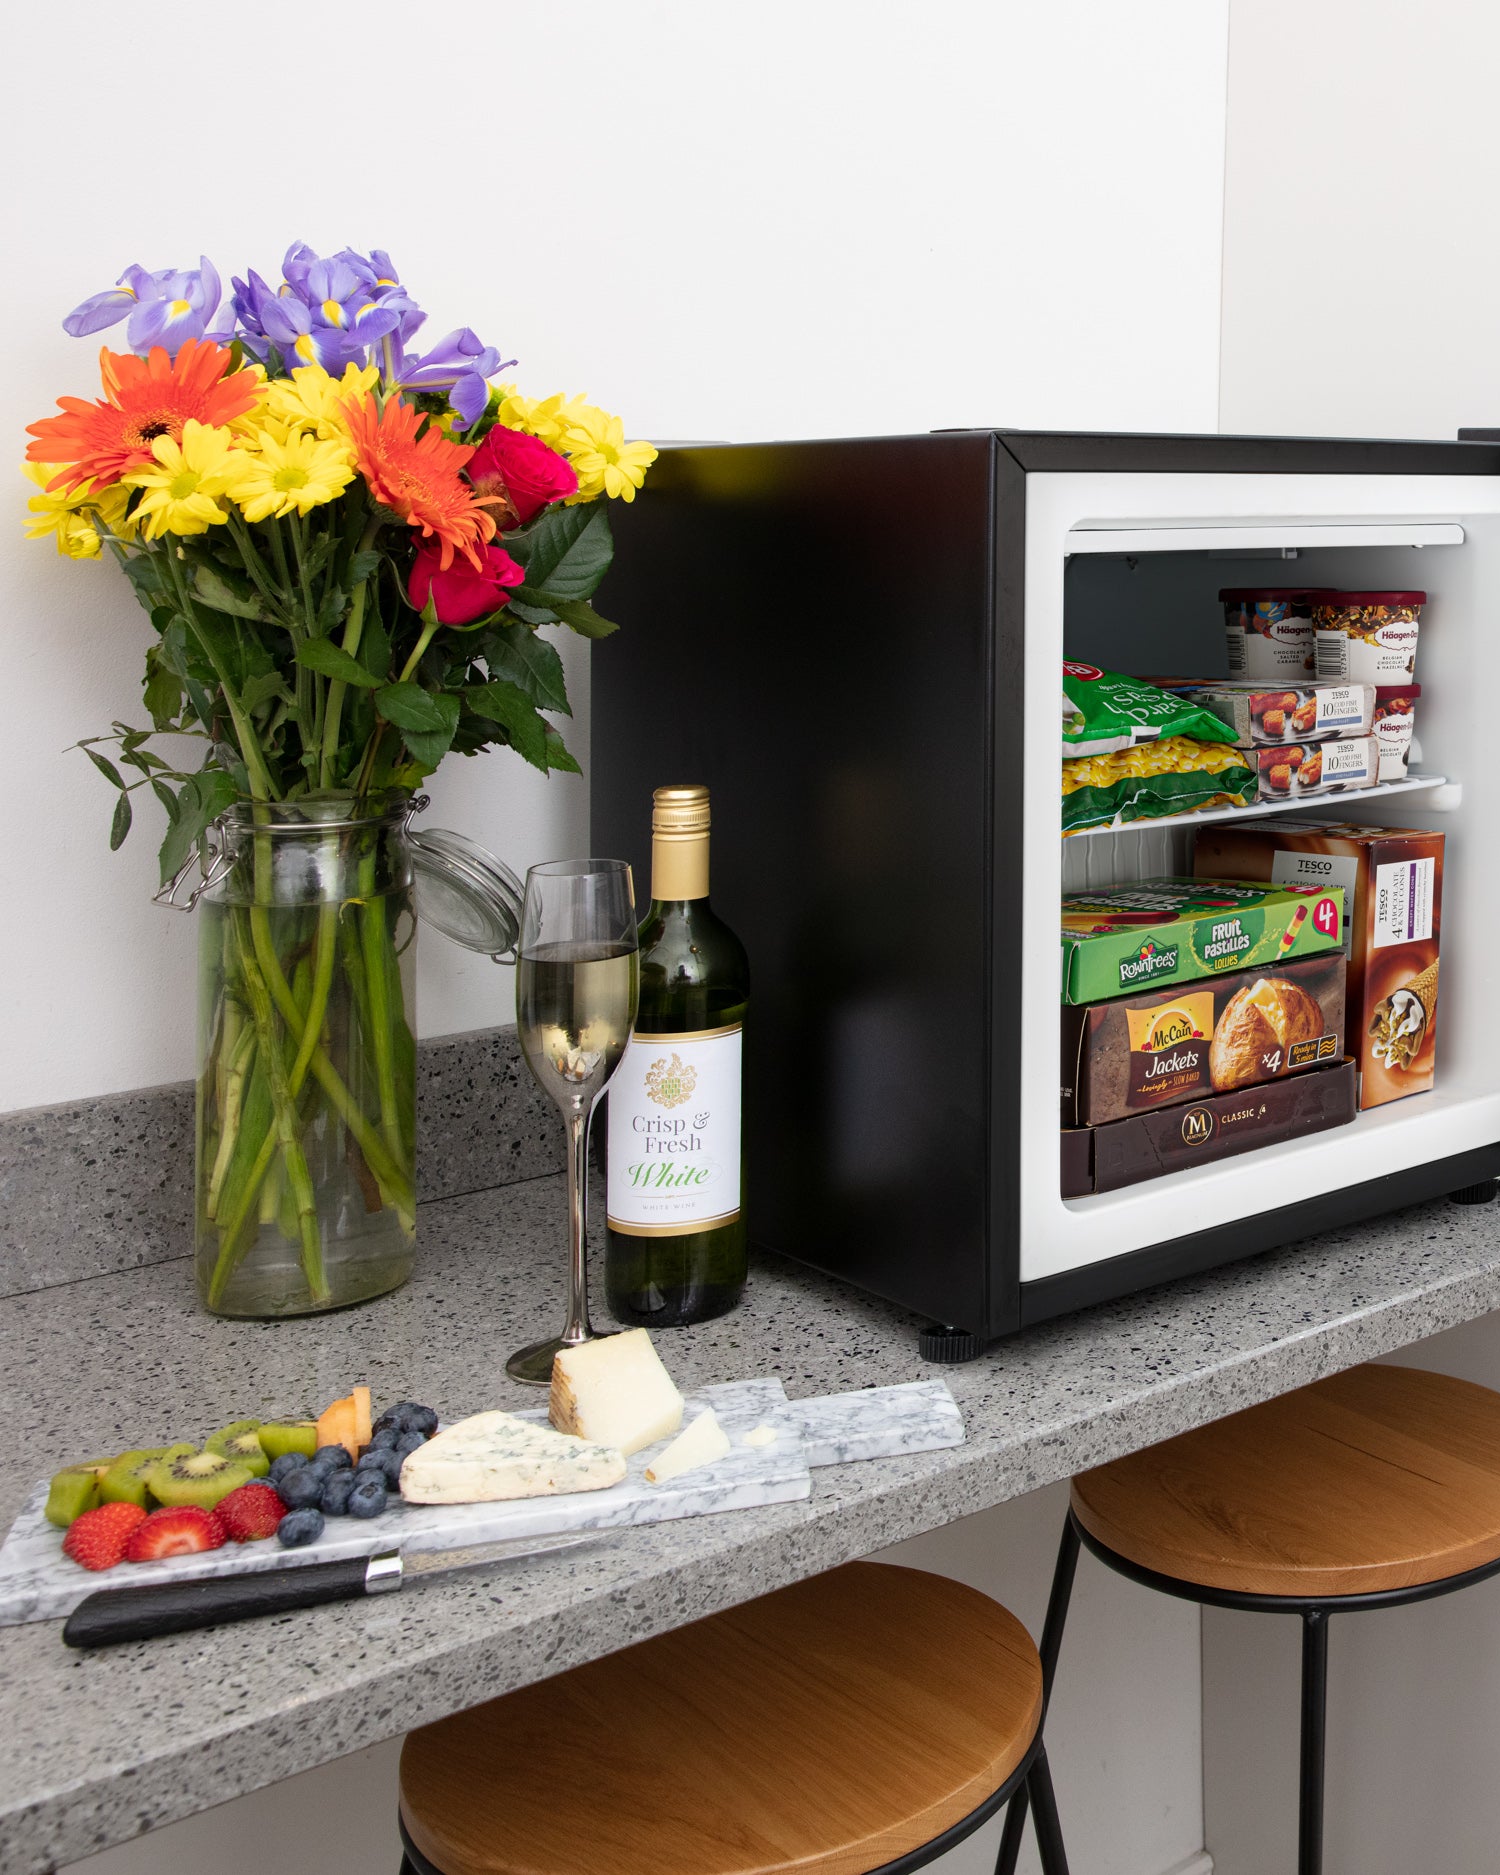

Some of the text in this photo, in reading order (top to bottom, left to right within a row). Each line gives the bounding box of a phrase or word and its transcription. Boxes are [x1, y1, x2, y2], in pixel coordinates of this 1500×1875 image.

[1277, 625, 1313, 636] Häagen-
[1382, 630, 1418, 641] Häagen-Da
[1322, 703, 1334, 717] 10
[1334, 706, 1359, 715] FINGERS
[1327, 757, 1339, 770] 10
[1339, 760, 1364, 769] FINGERS
[1298, 859, 1333, 871] TESCO
[1391, 871, 1403, 938] 4 CHOCOLATE
[1319, 902, 1334, 930] 4
[1153, 1025, 1192, 1049] McCain
[1145, 1051, 1199, 1078] Jackets
[1295, 1054, 1301, 1064] 5
[632, 1111, 711, 1136] Crisp &
[1221, 1108, 1255, 1124] CLASSIC
[1188, 1114, 1207, 1135] M
[644, 1133, 702, 1154] Fresh
[628, 1162, 709, 1188] White
